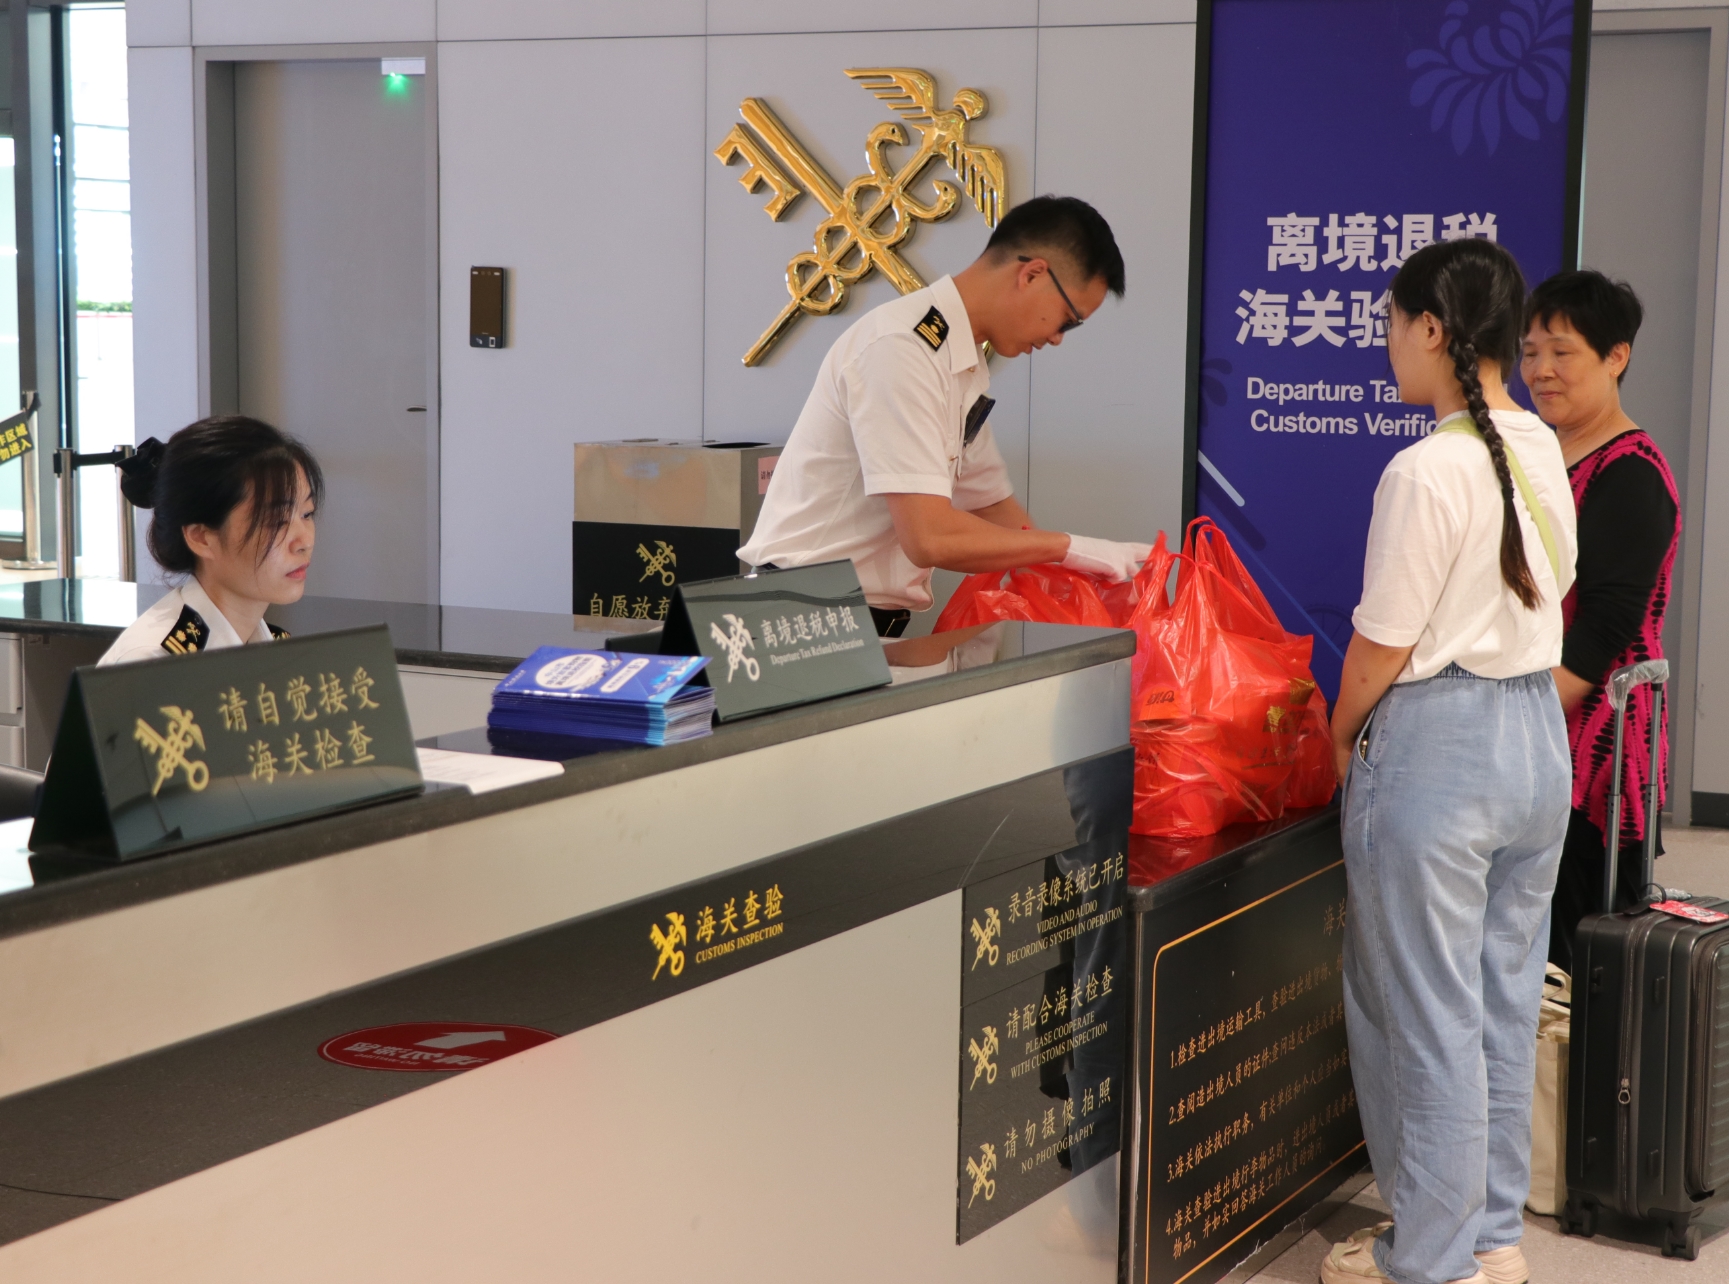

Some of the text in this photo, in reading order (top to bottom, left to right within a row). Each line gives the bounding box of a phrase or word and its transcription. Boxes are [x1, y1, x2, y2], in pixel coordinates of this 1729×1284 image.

[1235, 288, 1391, 348] 海关验
[1247, 377, 1363, 405] Departure
[1250, 409, 1358, 435] Customs
[590, 593, 670, 621] 自愿放弃
[761, 606, 859, 648] 离境退税申报
[770, 638, 864, 665] Departure Tax Refund Declaration
[218, 666, 380, 732] 请自觉接受
[247, 720, 375, 784] 海关检查
[696, 883, 784, 943] 海关查验
[1008, 852, 1124, 923] 录音录像系统已开启
[695, 922, 784, 963] CUSTOMS INSPECTION
[1006, 905, 1123, 965] RECORDING SYSTEM IN OPERATION
[1037, 900, 1097, 934] VIDEO AND AUDIO
[1323, 898, 1346, 936] 海关
[1006, 965, 1113, 1039] 请配合海关检查
[1011, 1021, 1108, 1079] WITH CUSTOMS INSPECTION
[1025, 1010, 1095, 1054] PLEASE COOPERATE
[1004, 1077, 1111, 1159] 请勿摄像拍照
[1021, 1122, 1094, 1174] NO PHOTOGRAPHY
